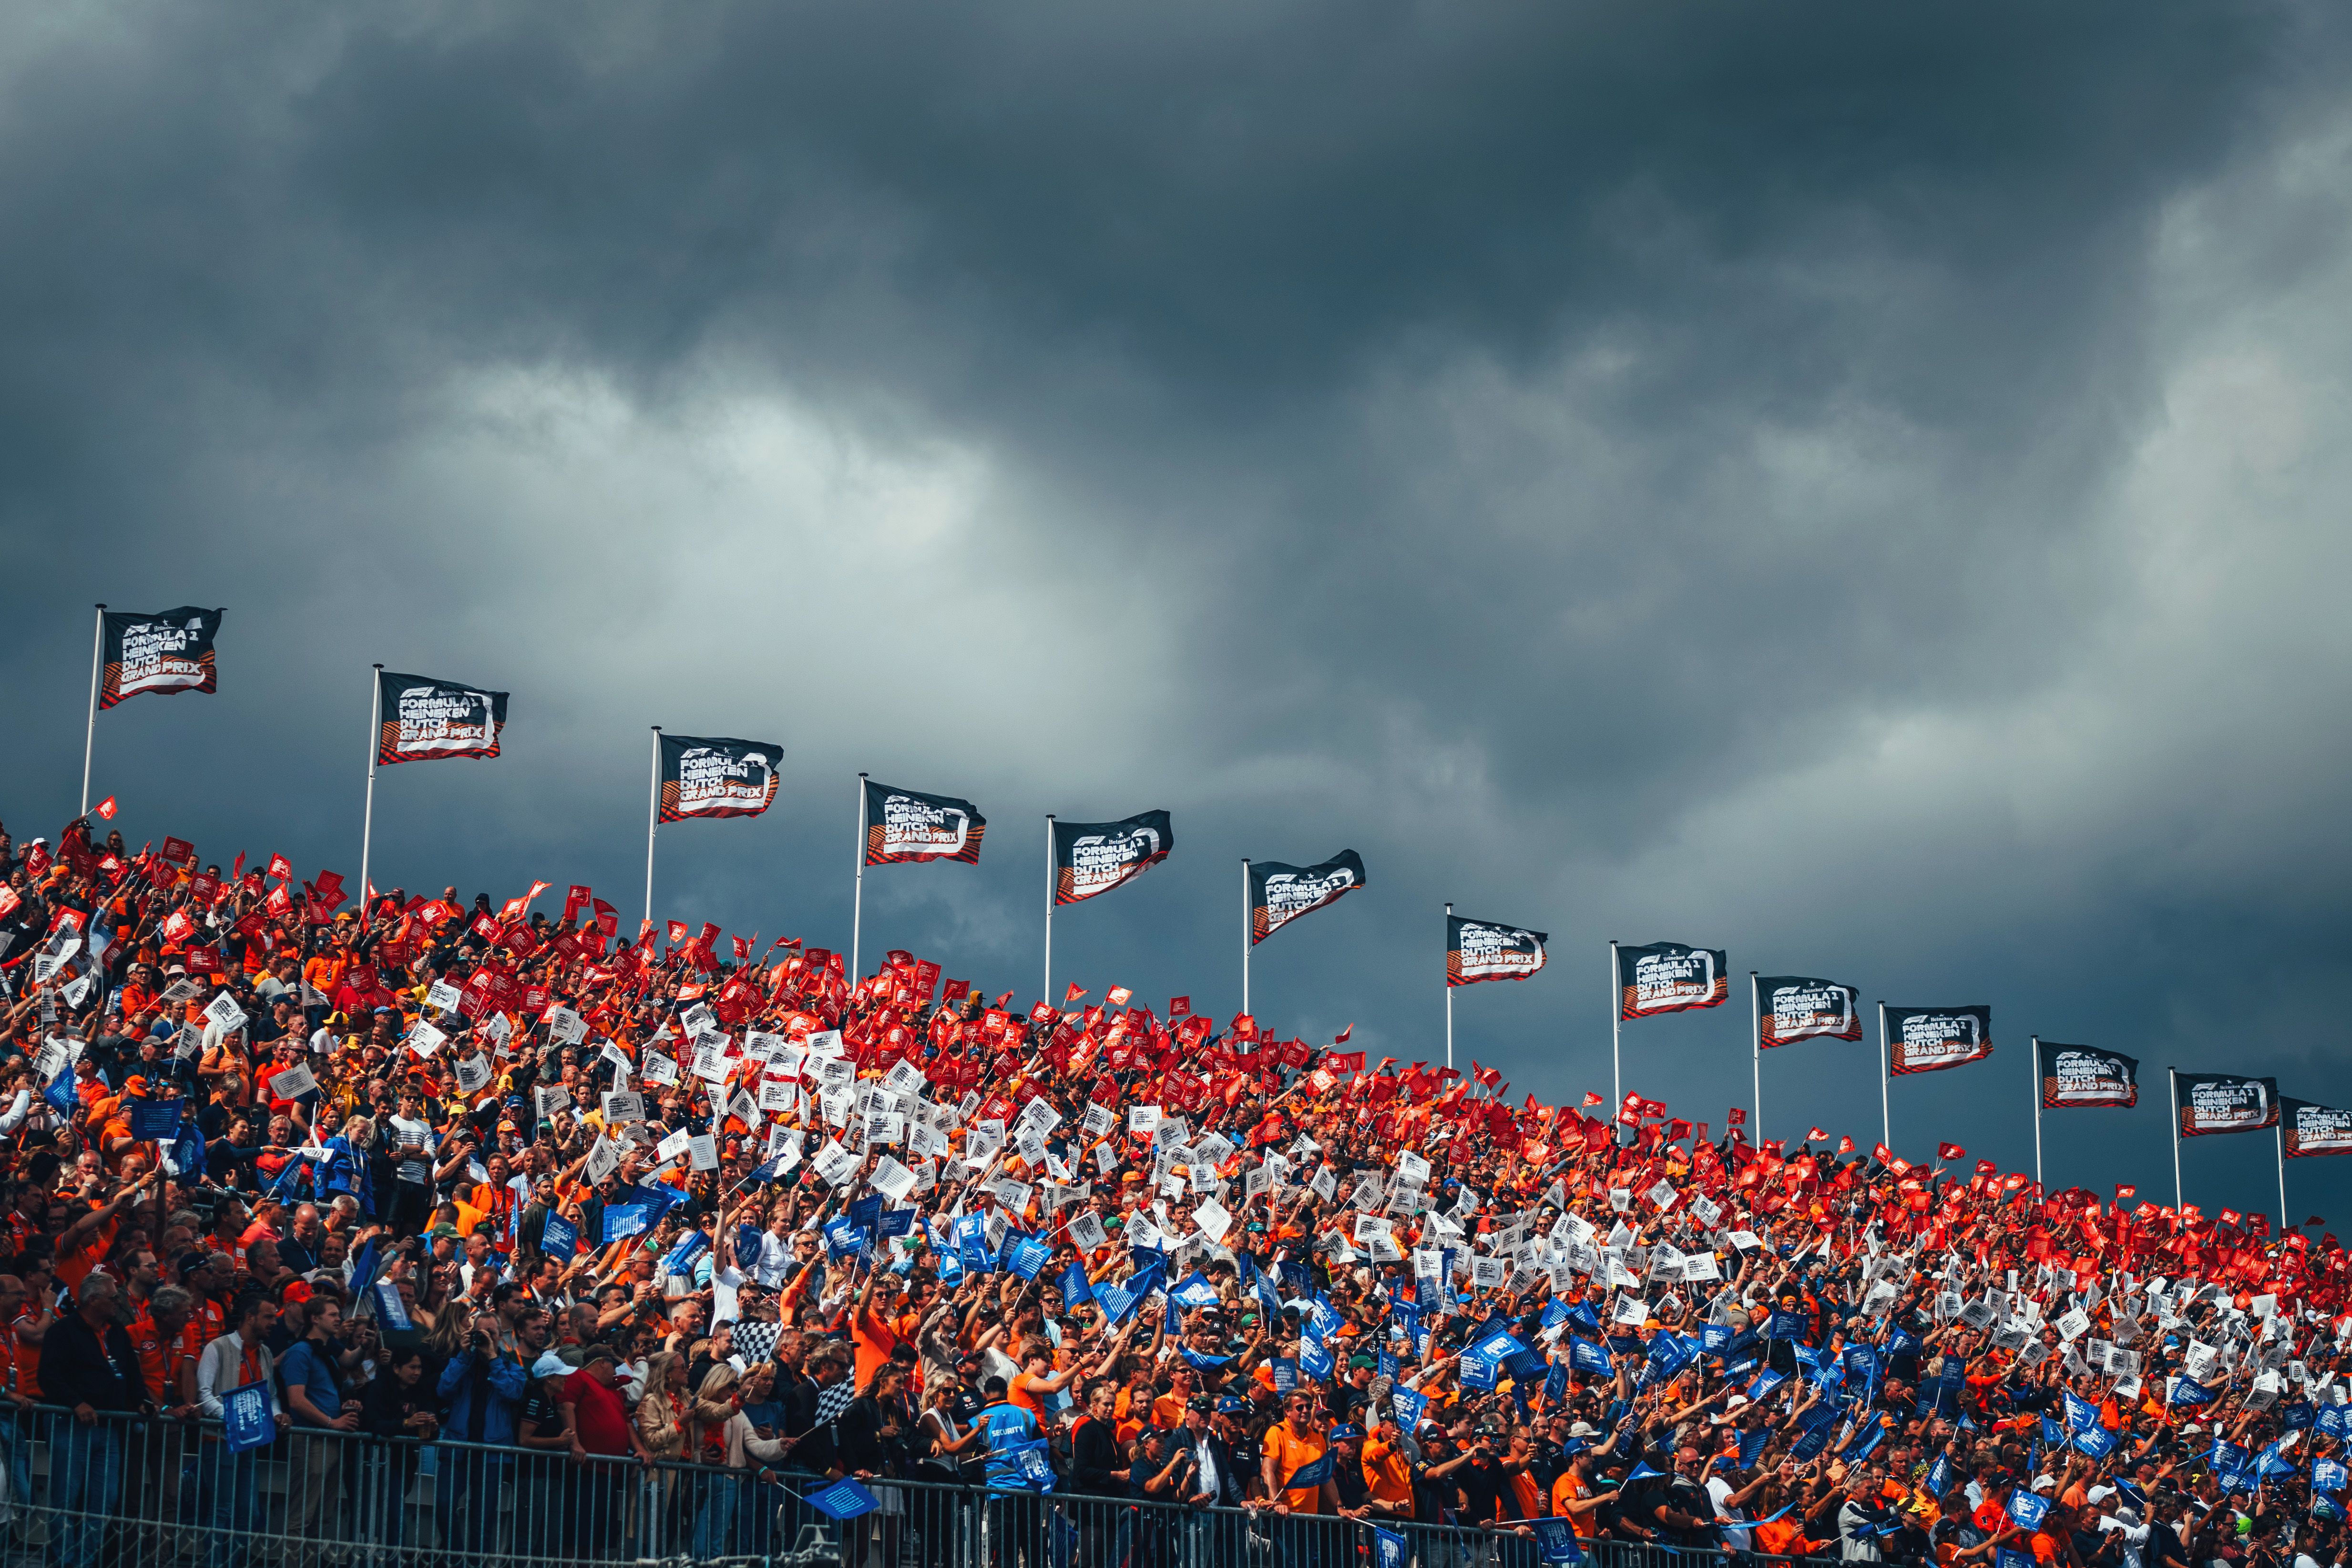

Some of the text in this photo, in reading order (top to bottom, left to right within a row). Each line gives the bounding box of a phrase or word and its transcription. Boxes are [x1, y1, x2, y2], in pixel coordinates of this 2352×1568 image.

[190, 631, 198, 641] 1
[123, 640, 186, 661] HEINEKEN
[122, 653, 160, 672] DUTCH
[121, 662, 202, 682] GRAND PRIX
[399, 697, 470, 709] FORMULA
[399, 707, 470, 719] HEINEKEN
[400, 717, 448, 730] DUTCH
[399, 726, 483, 740] GRAND PRIX
[680, 765, 747, 780] HEINEKEN
[680, 776, 723, 790] DUTCH
[680, 786, 762, 801] GRAND PRIX
[885, 812, 944, 824] HEINEKEN
[886, 821, 929, 834] DUTCH
[885, 831, 958, 843] GRAND PRIX
[1109, 836, 1131, 845] Heineken
[1073, 838, 1145, 857] FORMULA 1
[1074, 848, 1138, 866] HEINEKEN
[1074, 862, 1119, 876] DUTCH
[1074, 871, 1121, 884] GRAND
[1266, 881, 1331, 894] FORMULA
[1268, 899, 1311, 914] DUTCH
[1268, 908, 1302, 922] GRA
[1461, 938, 1520, 948] HEINEKEN
[1461, 946, 1501, 958] DUTCH
[1462, 954, 1533, 966] GRAND PRIX
[1636, 960, 1700, 975] FORMULA 1
[1637, 969, 1692, 984] HEINEKEN
[1637, 979, 1674, 993] DUTCH
[1637, 985, 1706, 1001] GRAND PRIX
[1773, 992, 1830, 1004] FORMULA
[1774, 1000, 1830, 1013] HEINEKEN
[1774, 1010, 1813, 1022] DUTCH
[1775, 1016, 1843, 1029] GRAND PRIX
[1902, 1021, 1959, 1033] FORMULA
[1903, 1029, 1960, 1041] HEINEKEN
[1904, 1038, 1943, 1049] DUTCH
[1904, 1044, 1972, 1056] GRAND PRIX
[2056, 1059, 2110, 1068] FORMULA
[2057, 1067, 2112, 1076] HEINEKEN
[2058, 1075, 2095, 1084] DUTCH
[2058, 1082, 2124, 1091] GRAND PRIX
[2192, 1089, 2246, 1098] FORMULA
[2193, 1096, 2247, 1106] HEINEKEN
[2234, 1110, 2259, 1119] PRIX
[2298, 1119, 2350, 1127] HEINEKEN
[2298, 1125, 2333, 1135] DUTCH
[2299, 1132, 2336, 1142] GRAND
[992, 1425, 1023, 1437] SECURITY
